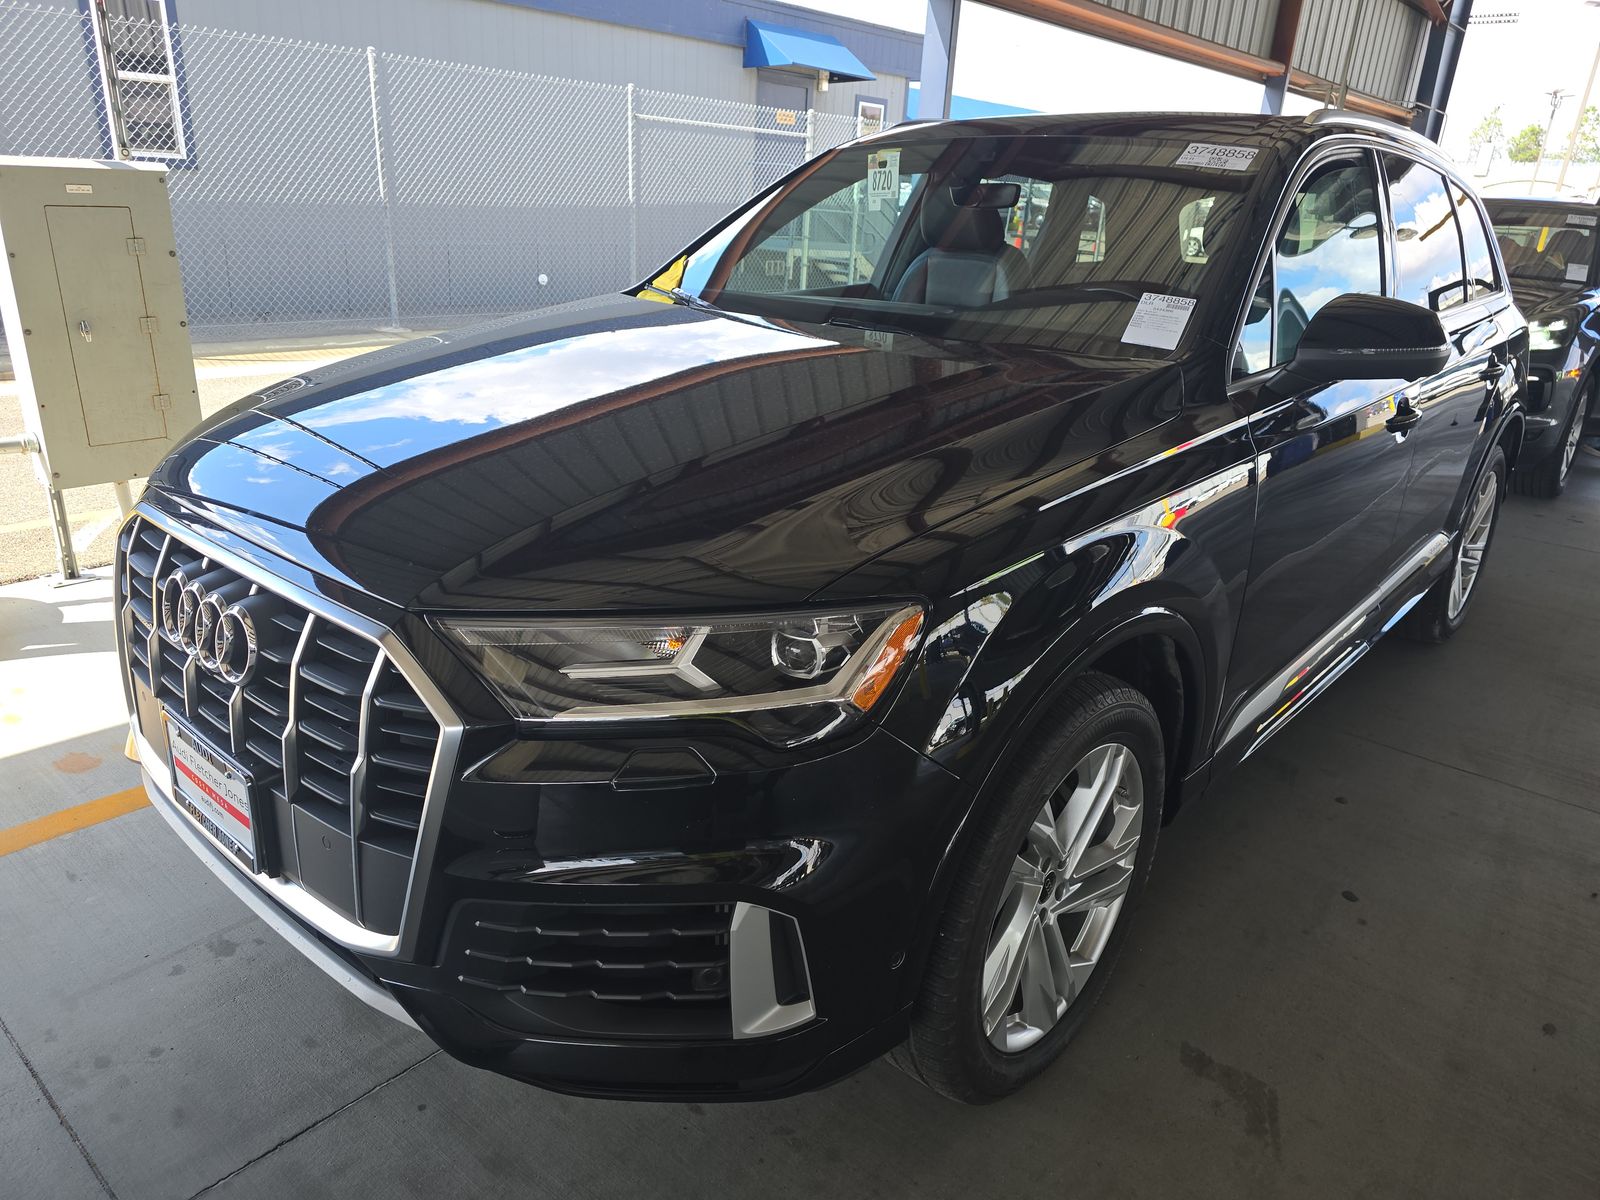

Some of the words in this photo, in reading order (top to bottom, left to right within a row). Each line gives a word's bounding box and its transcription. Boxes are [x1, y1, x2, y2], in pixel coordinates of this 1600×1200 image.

[1187, 145, 1257, 160] 3748858
[873, 170, 893, 191] 8720
[1144, 293, 1196, 307] 3748858
[172, 739, 189, 761] Audi
[190, 755, 223, 790] Fletcher
[224, 781, 250, 813] Jones
[191, 774, 210, 794] COSTA
[211, 791, 230, 810] MESA
[189, 805, 217, 838] FLETCHER
